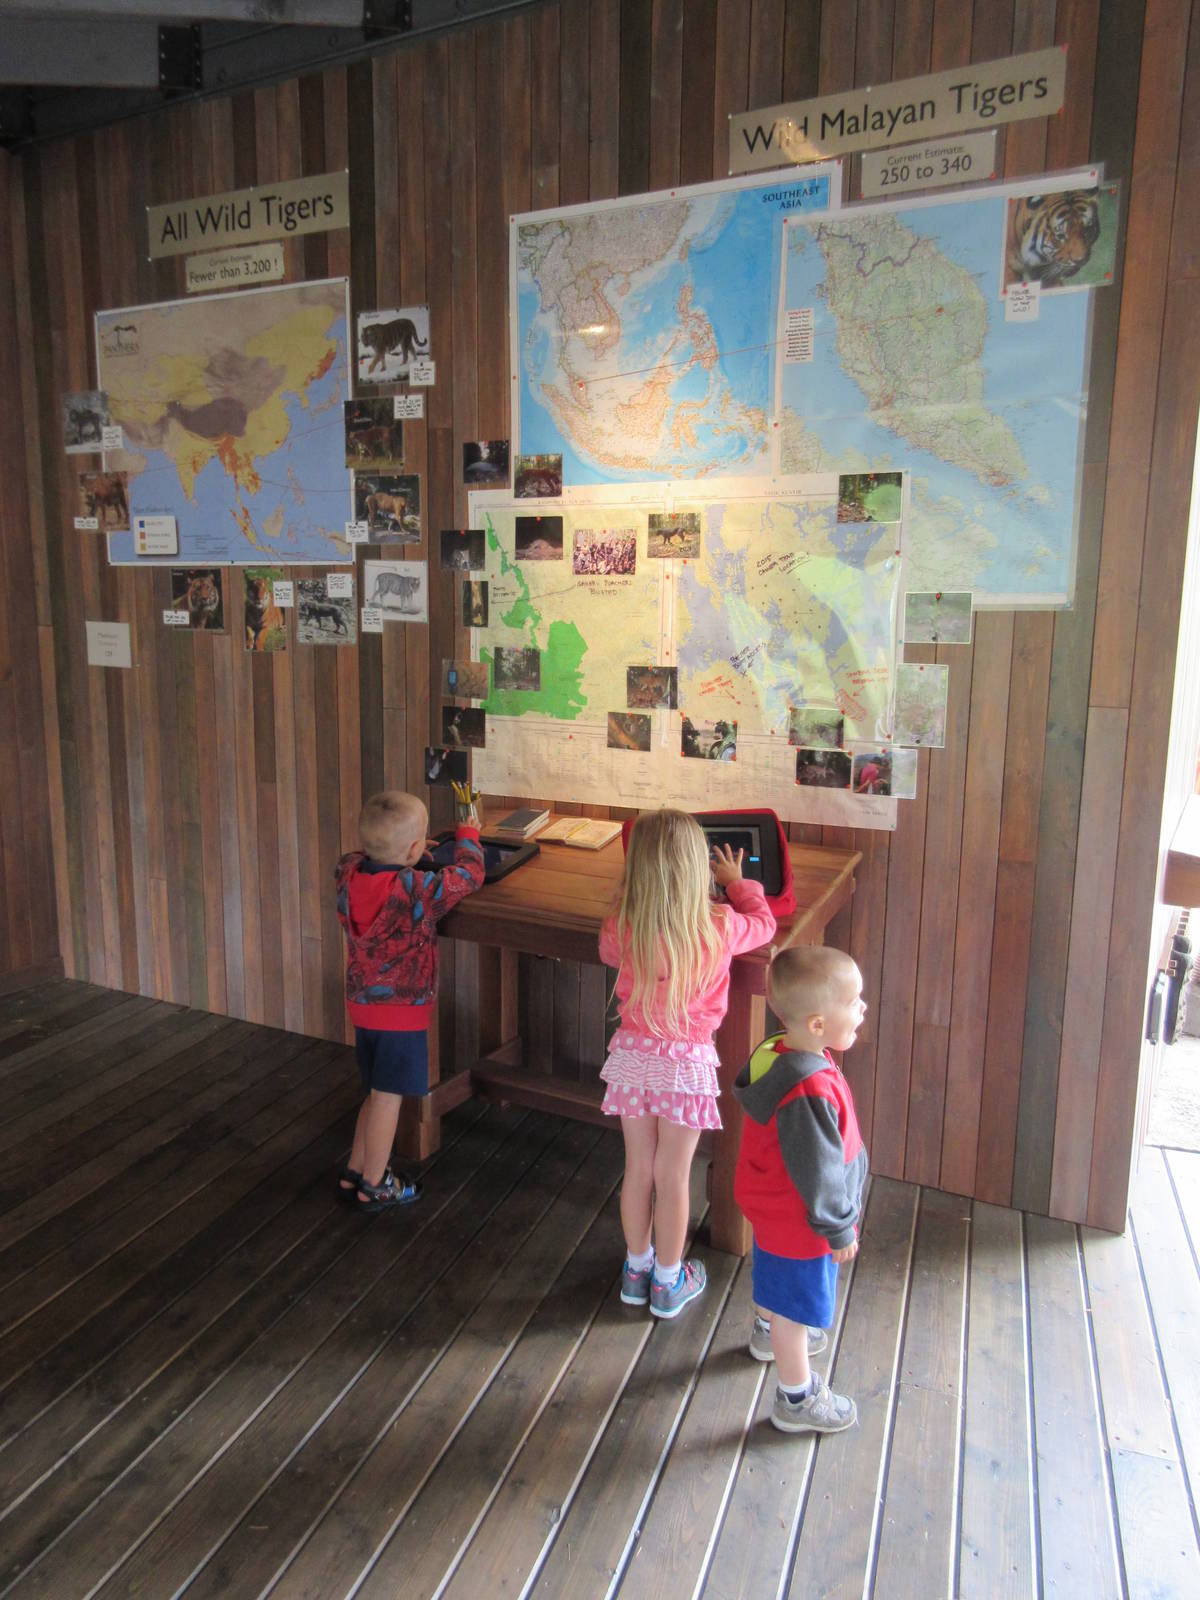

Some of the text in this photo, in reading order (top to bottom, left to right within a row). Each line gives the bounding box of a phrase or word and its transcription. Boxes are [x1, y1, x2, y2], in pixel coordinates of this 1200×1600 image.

[821, 99, 936, 140] Malayan
[949, 77, 1048, 118] Tigers
[887, 152, 922, 166] Current
[880, 154, 972, 186] 250 to 340
[762, 185, 820, 203] SOUTHEAST
[779, 199, 802, 210] ASIA
[161, 194, 334, 243] All Wild Tigers
[189, 271, 217, 284] Fewer
[220, 266, 241, 279] than
